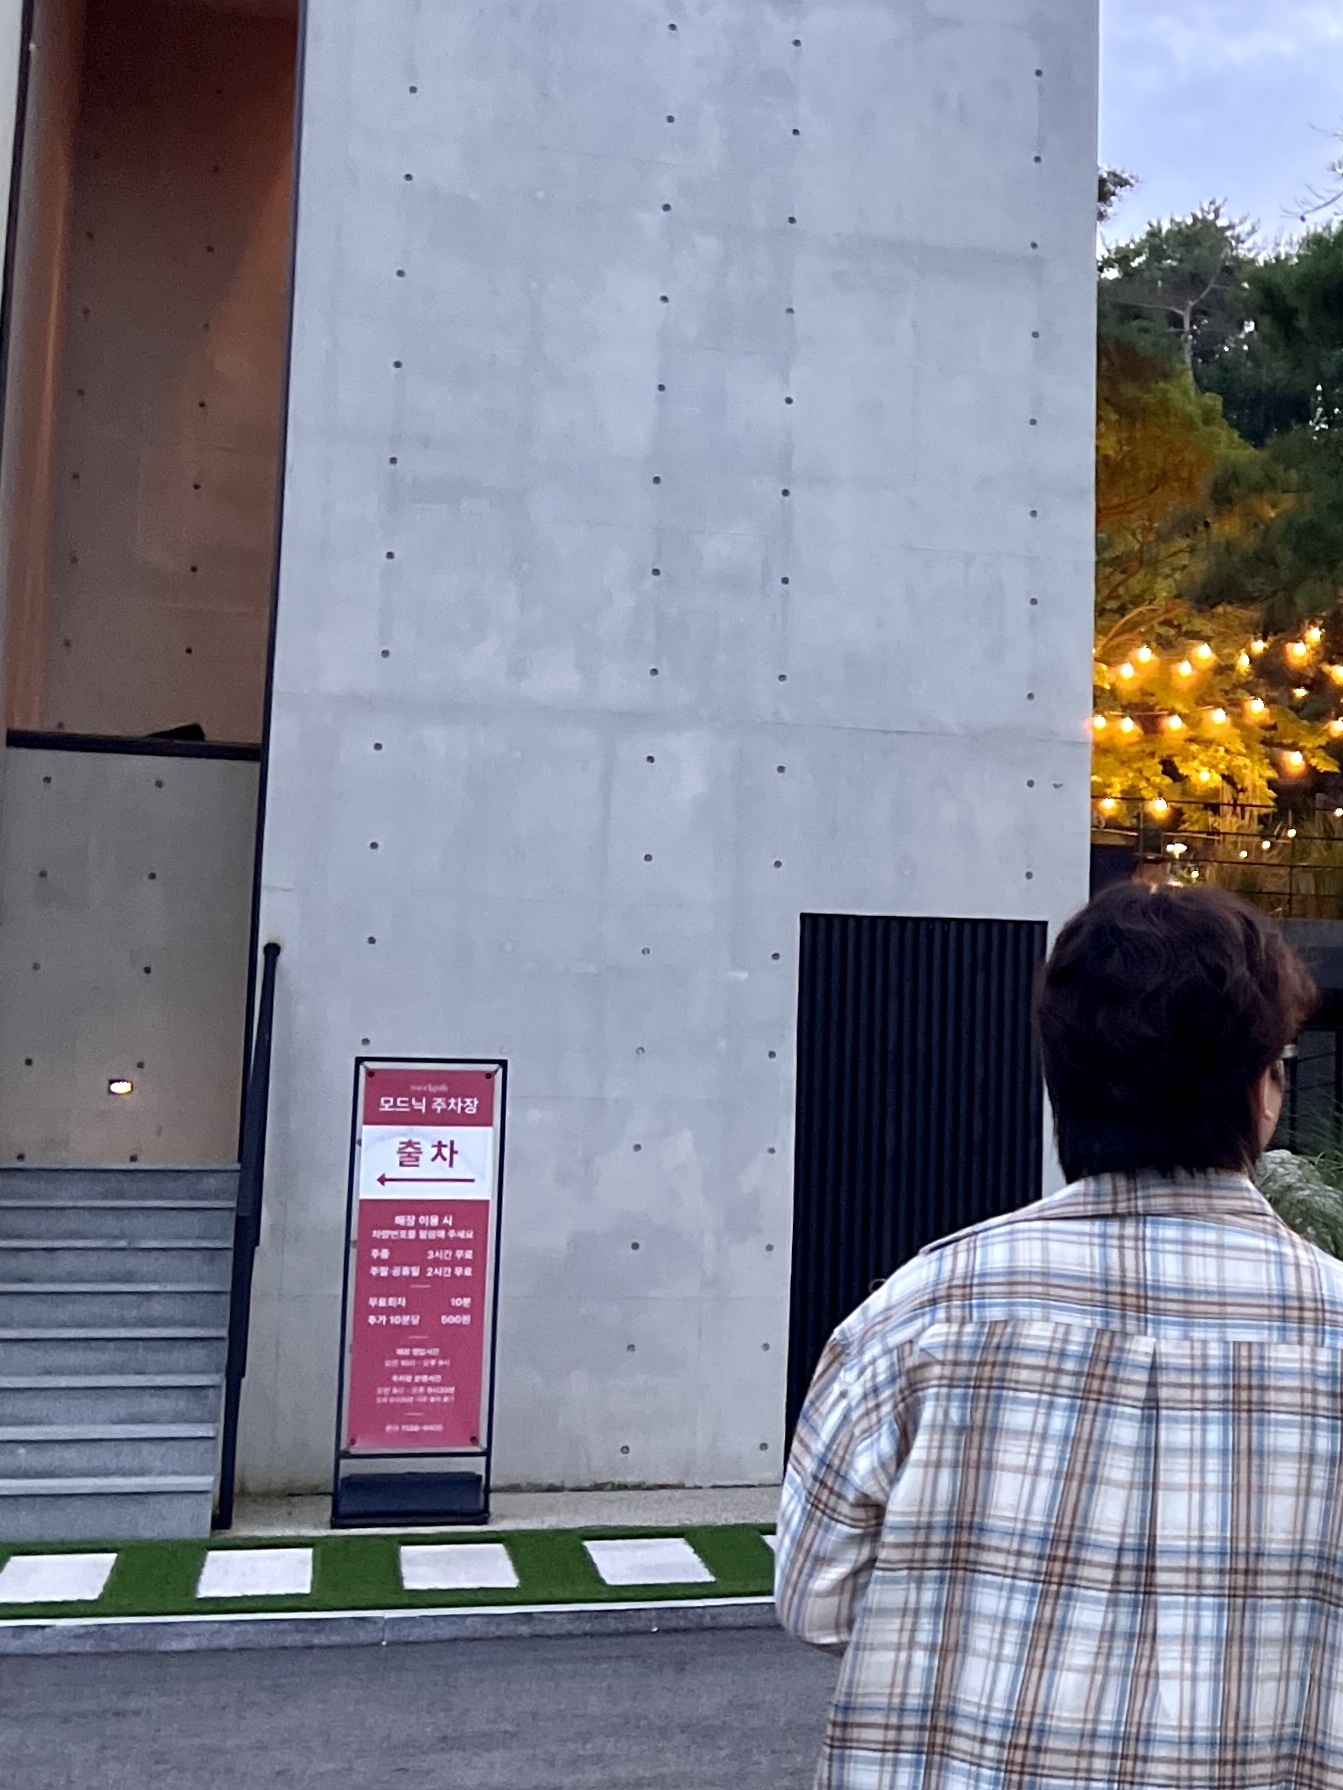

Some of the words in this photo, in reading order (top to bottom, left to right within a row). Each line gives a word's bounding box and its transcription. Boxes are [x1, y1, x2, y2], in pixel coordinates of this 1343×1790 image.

[379, 1096, 426, 1114] 모드닉
[431, 1096, 479, 1114] 주차장
[442, 1215, 453, 1227] 시
[427, 1249, 453, 1261] 3시간
[426, 1266, 452, 1278] 2시간
